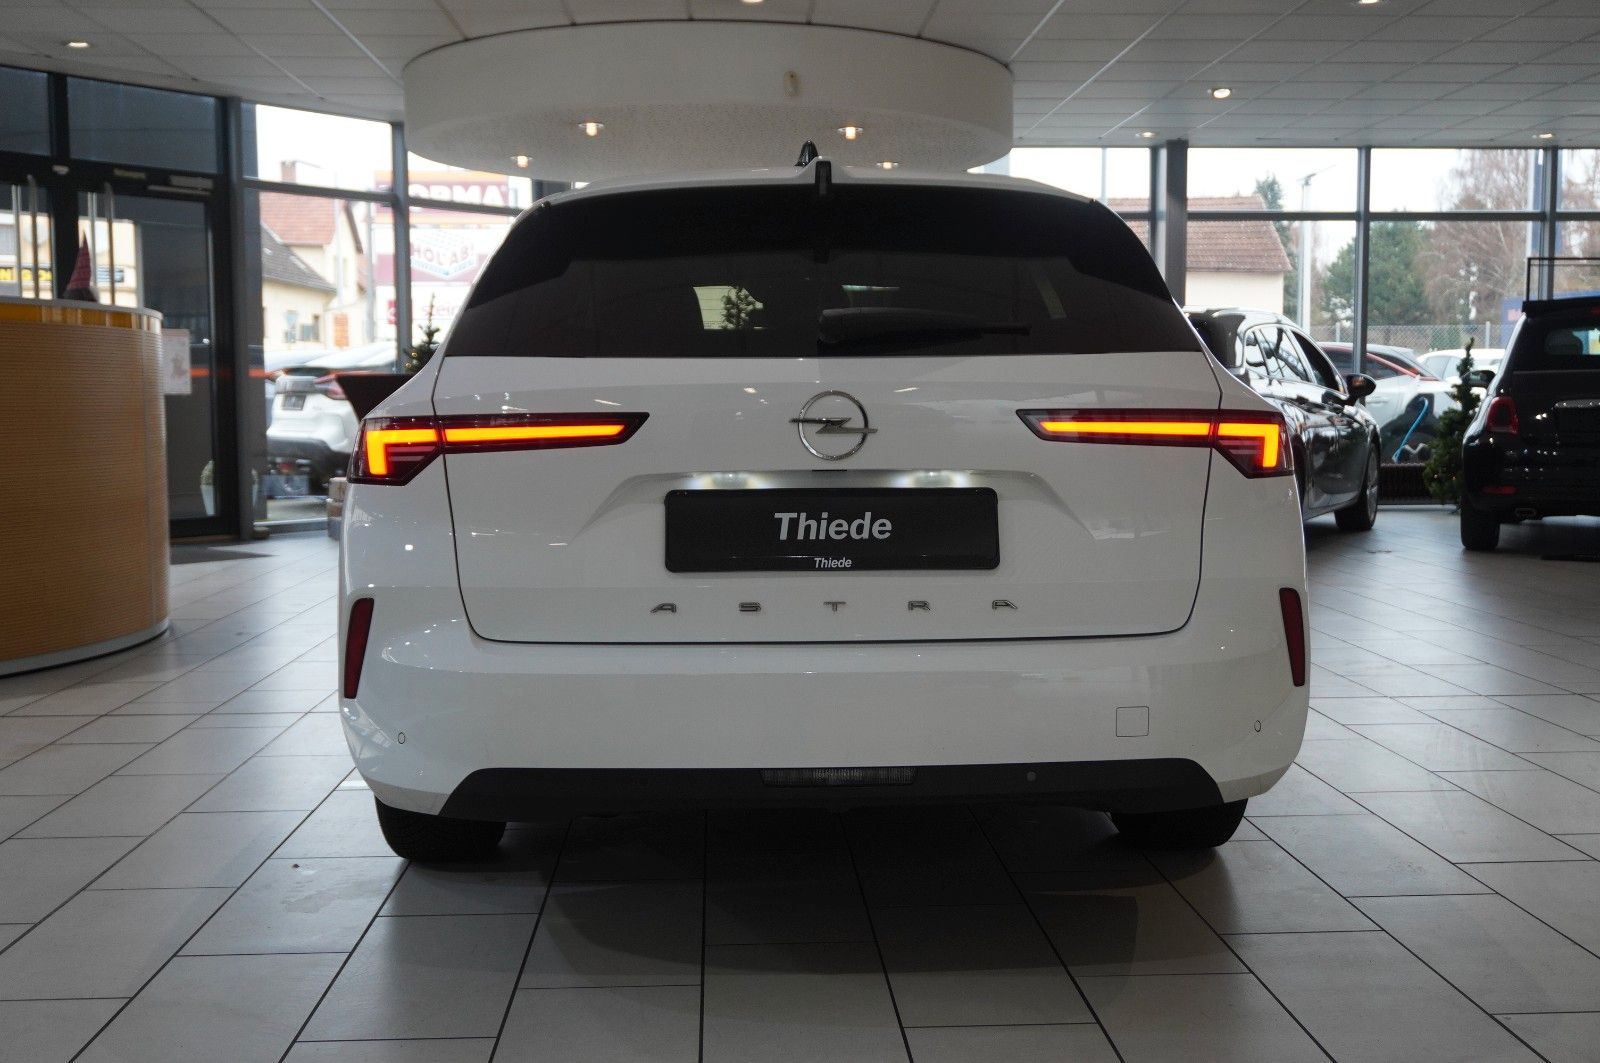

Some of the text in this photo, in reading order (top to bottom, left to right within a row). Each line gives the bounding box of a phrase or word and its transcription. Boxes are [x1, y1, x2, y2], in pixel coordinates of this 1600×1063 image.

[379, 183, 506, 211] ORMA
[774, 511, 892, 540] Thiede
[814, 557, 852, 568] Thiede
[650, 599, 1018, 613] ASTRA
